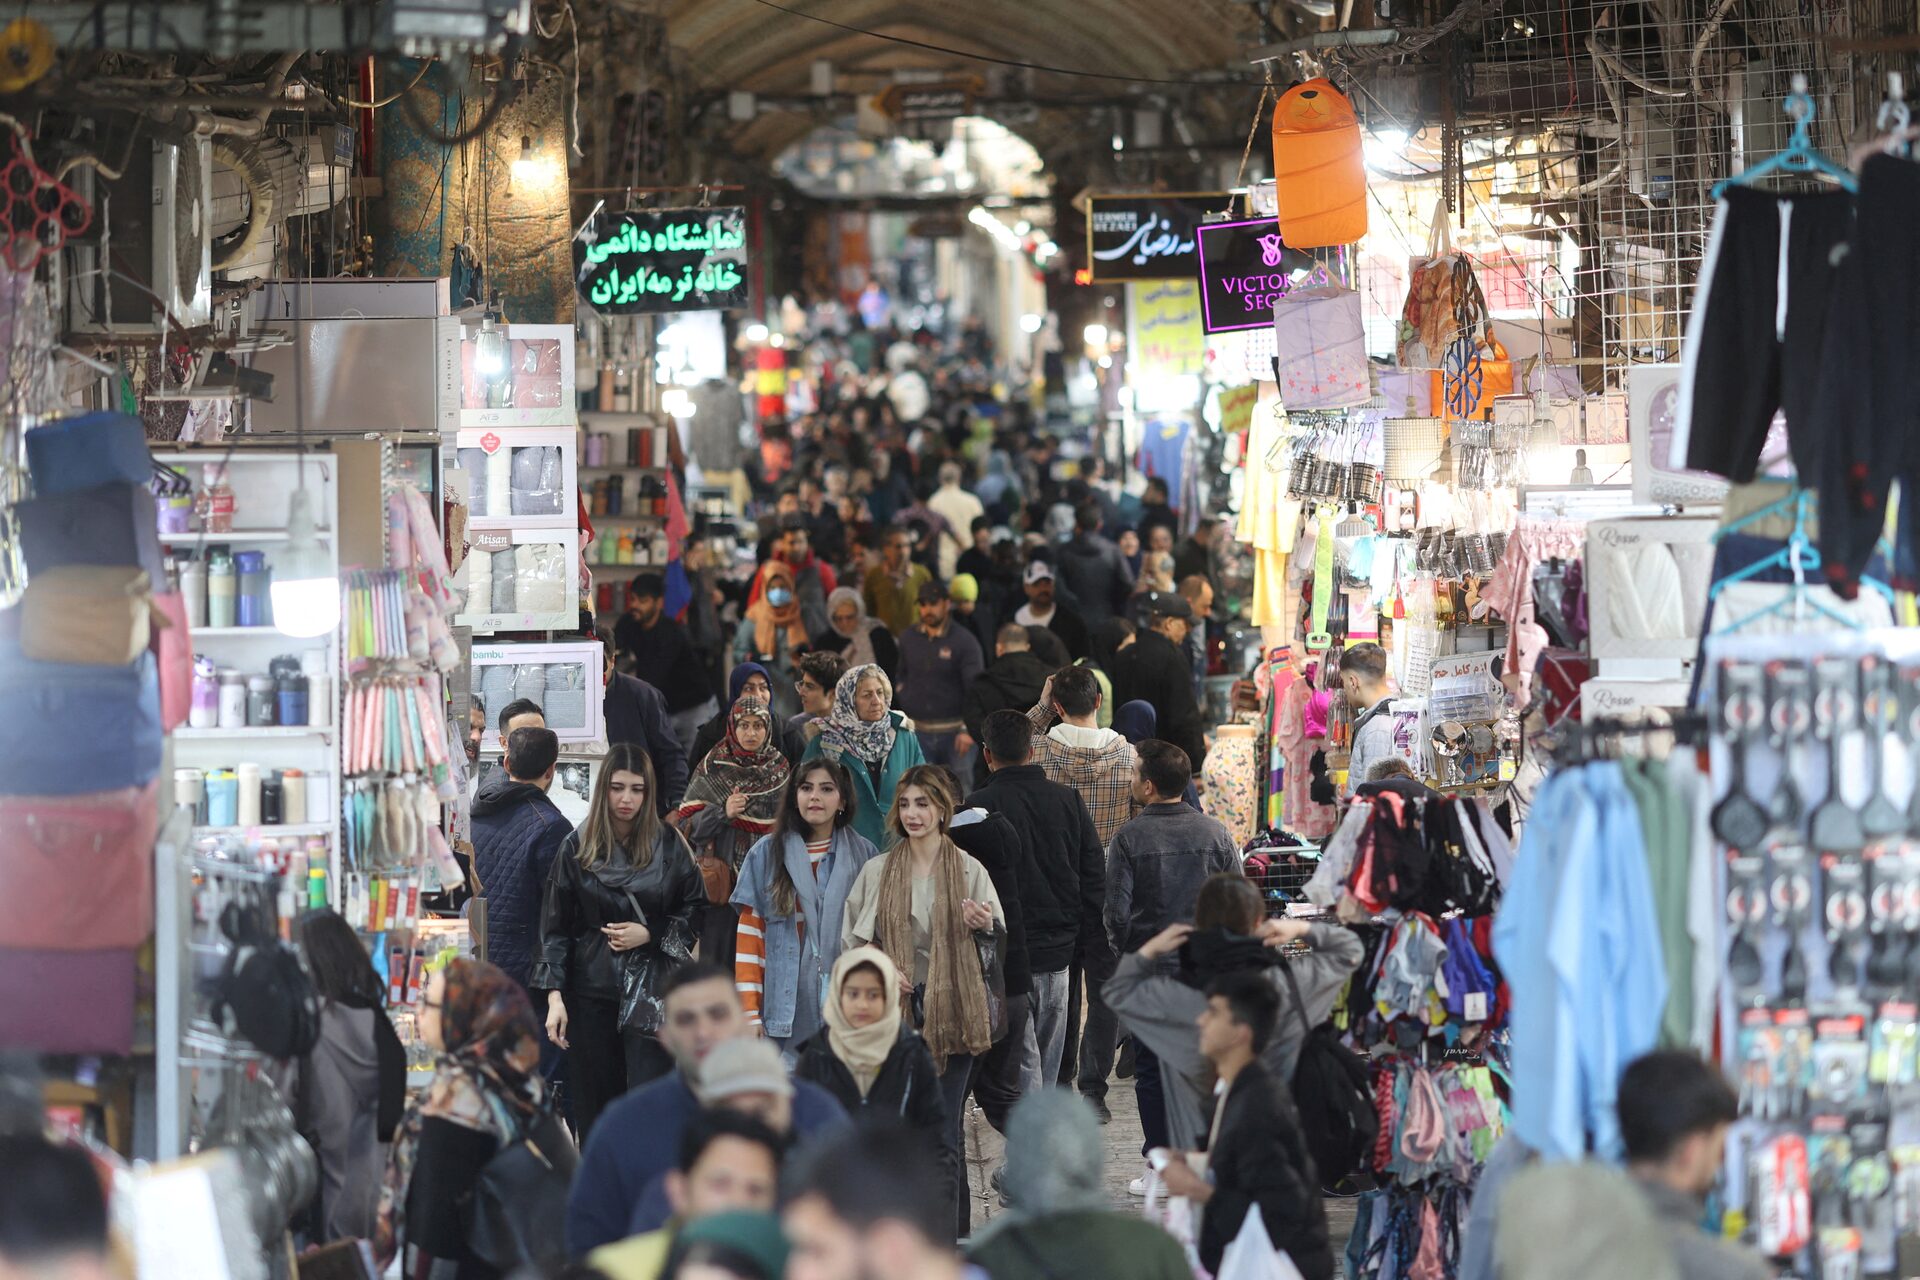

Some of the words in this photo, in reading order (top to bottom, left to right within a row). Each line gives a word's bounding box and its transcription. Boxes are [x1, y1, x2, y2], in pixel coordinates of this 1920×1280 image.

[587, 223, 651, 263] دائمی
[591, 266, 646, 305] ایران
[694, 262, 742, 292] خانه
[1222, 268, 1329, 294] VICTORA'S
[475, 533, 508, 546] Atisan
[472, 650, 504, 659] bambu
